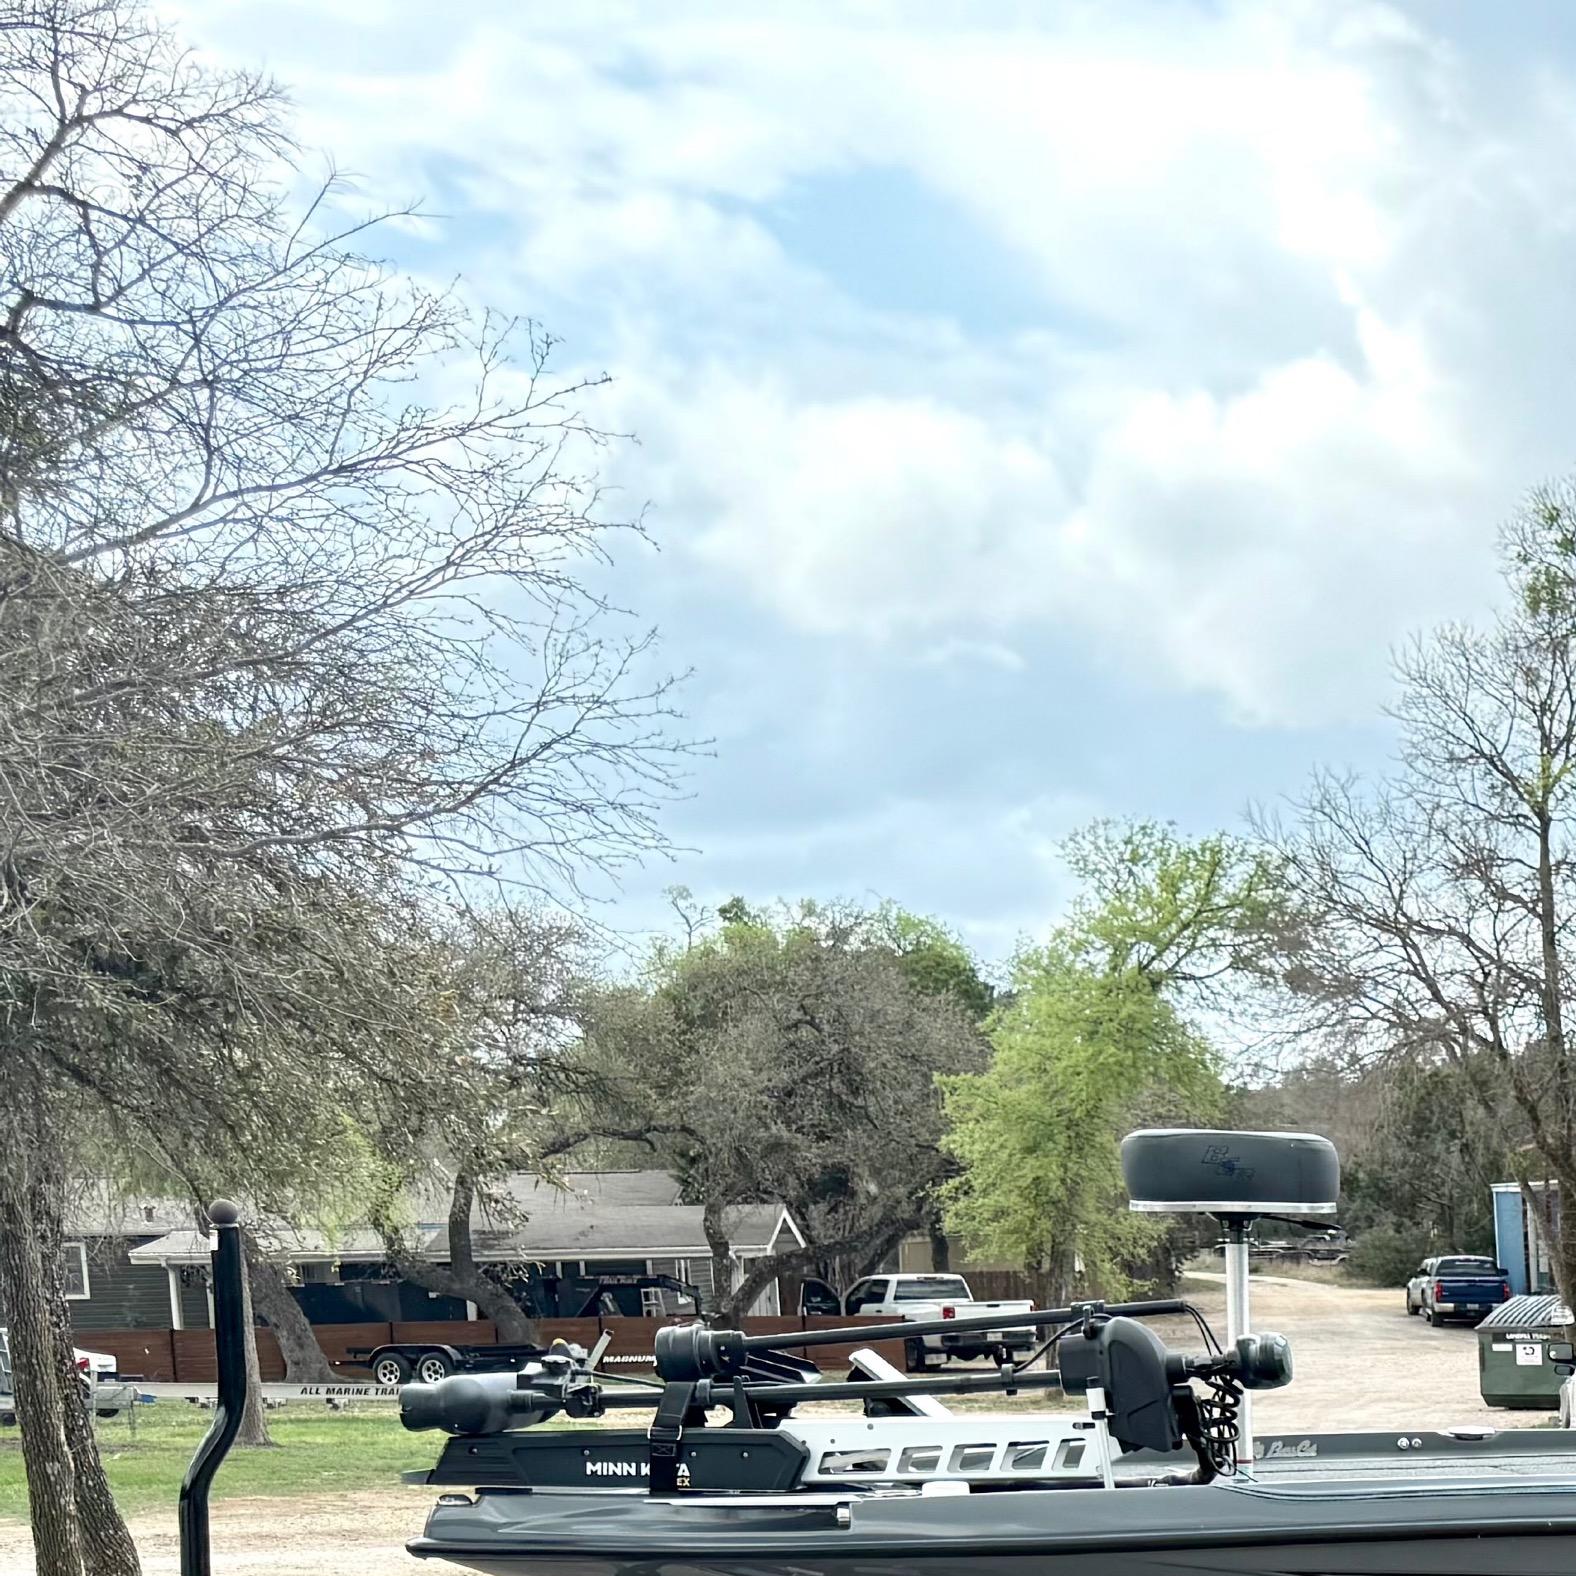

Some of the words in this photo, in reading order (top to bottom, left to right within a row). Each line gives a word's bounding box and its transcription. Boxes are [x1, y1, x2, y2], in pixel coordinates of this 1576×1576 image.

[300, 1387, 321, 1395] ALL
[325, 1387, 371, 1396] MARINE
[374, 1387, 400, 1396] TRAI
[585, 1461, 637, 1476] MINN
[640, 1462, 691, 1477] KA
